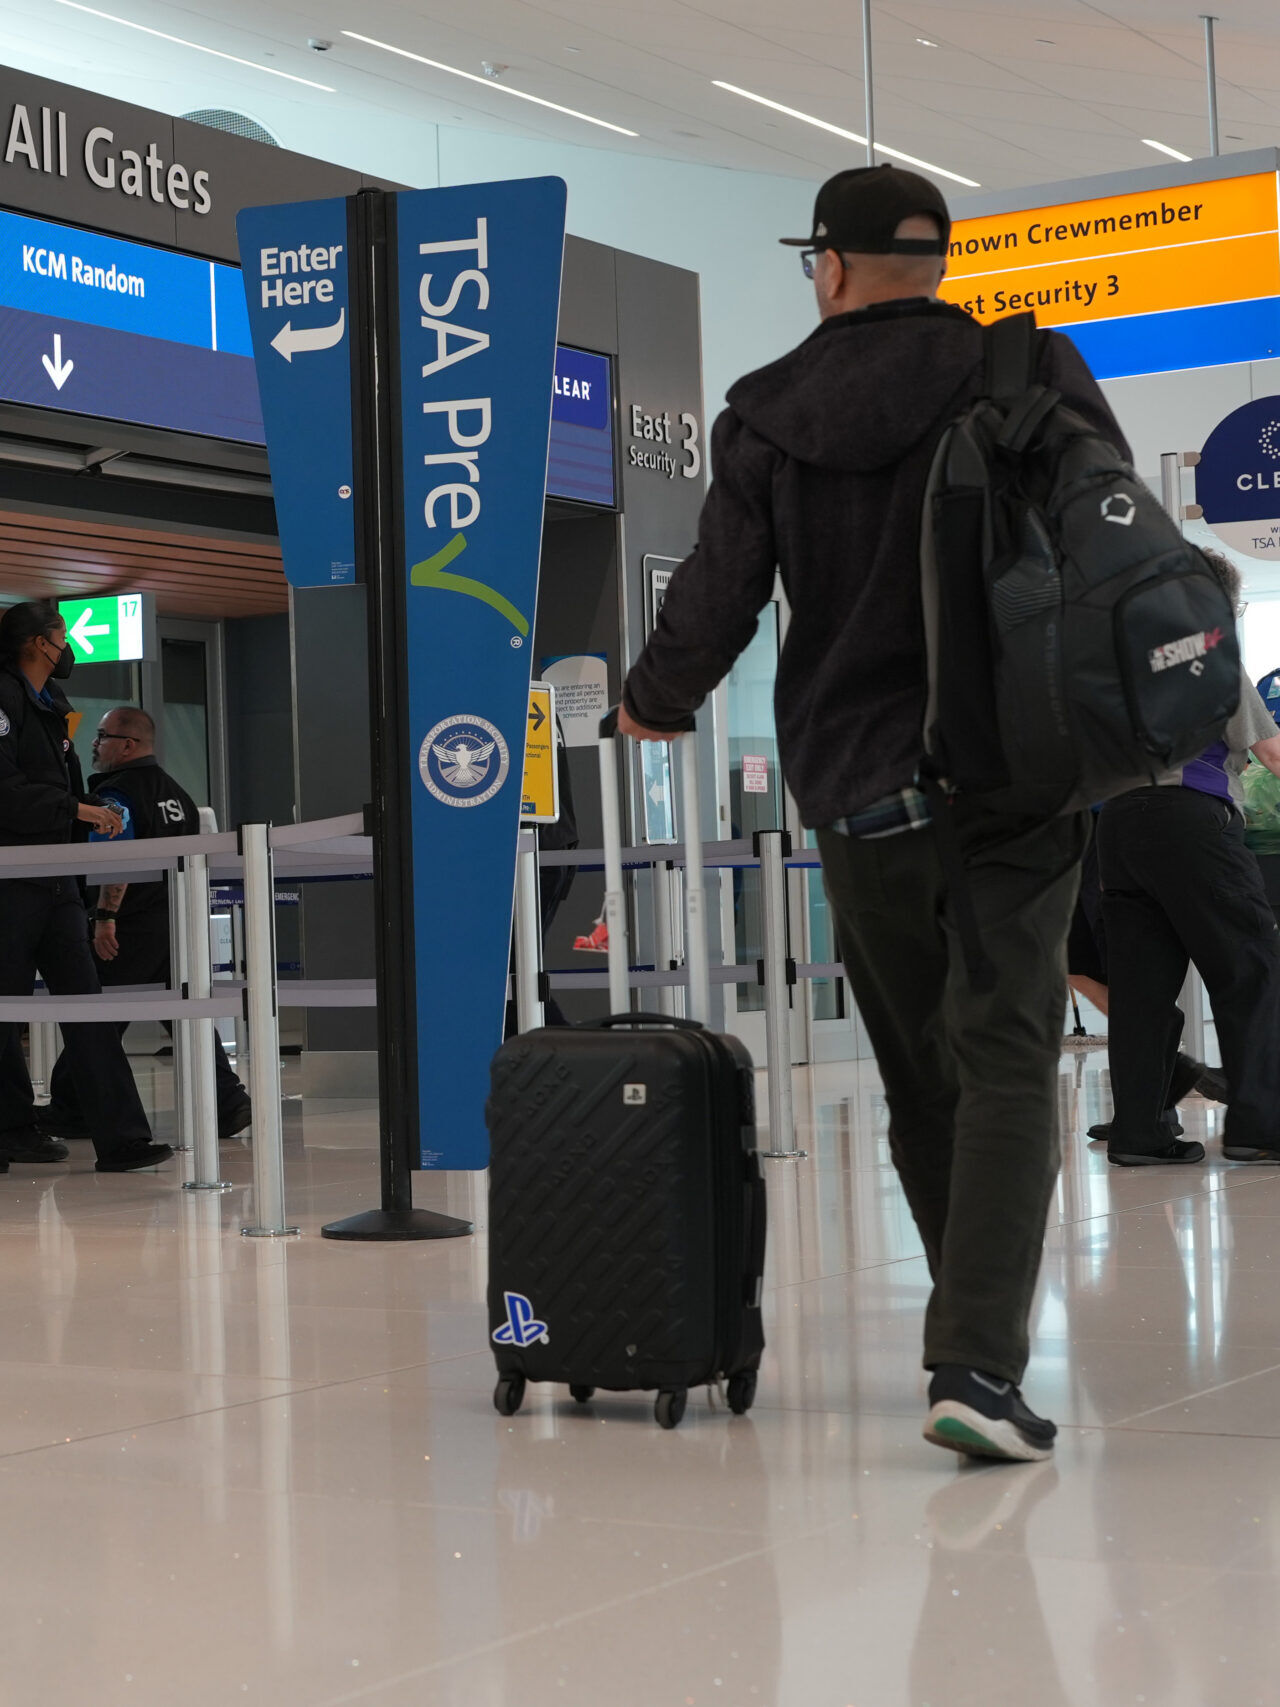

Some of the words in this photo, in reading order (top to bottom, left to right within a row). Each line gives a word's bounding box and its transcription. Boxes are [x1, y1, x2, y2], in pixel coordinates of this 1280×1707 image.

[5, 103, 67, 177] All
[84, 127, 211, 214] Gates
[949, 232, 1018, 257] nown
[1027, 202, 1203, 245] Crewmember
[22, 244, 67, 280] KCM
[72, 257, 145, 298] Random
[260, 244, 343, 276] Enter
[261, 279, 334, 308] Here
[420, 217, 491, 378] TSA
[994, 281, 1097, 312] Security
[1107, 275, 1120, 296] 3
[554, 375, 590, 400] LEAR
[631, 404, 672, 444] East
[679, 412, 701, 479] 3
[628, 445, 676, 479] Security
[1236, 471, 1280, 491] CLE
[1252, 537, 1275, 549] TSA
[121, 601, 138, 618] 17
[565, 698, 587, 706] property
[571, 684, 592, 692] entering
[419, 714, 482, 769] TRANSPORTATION
[425, 781, 502, 808] ADMINISTRATION
[274, 892, 300, 901] EMERGENC
